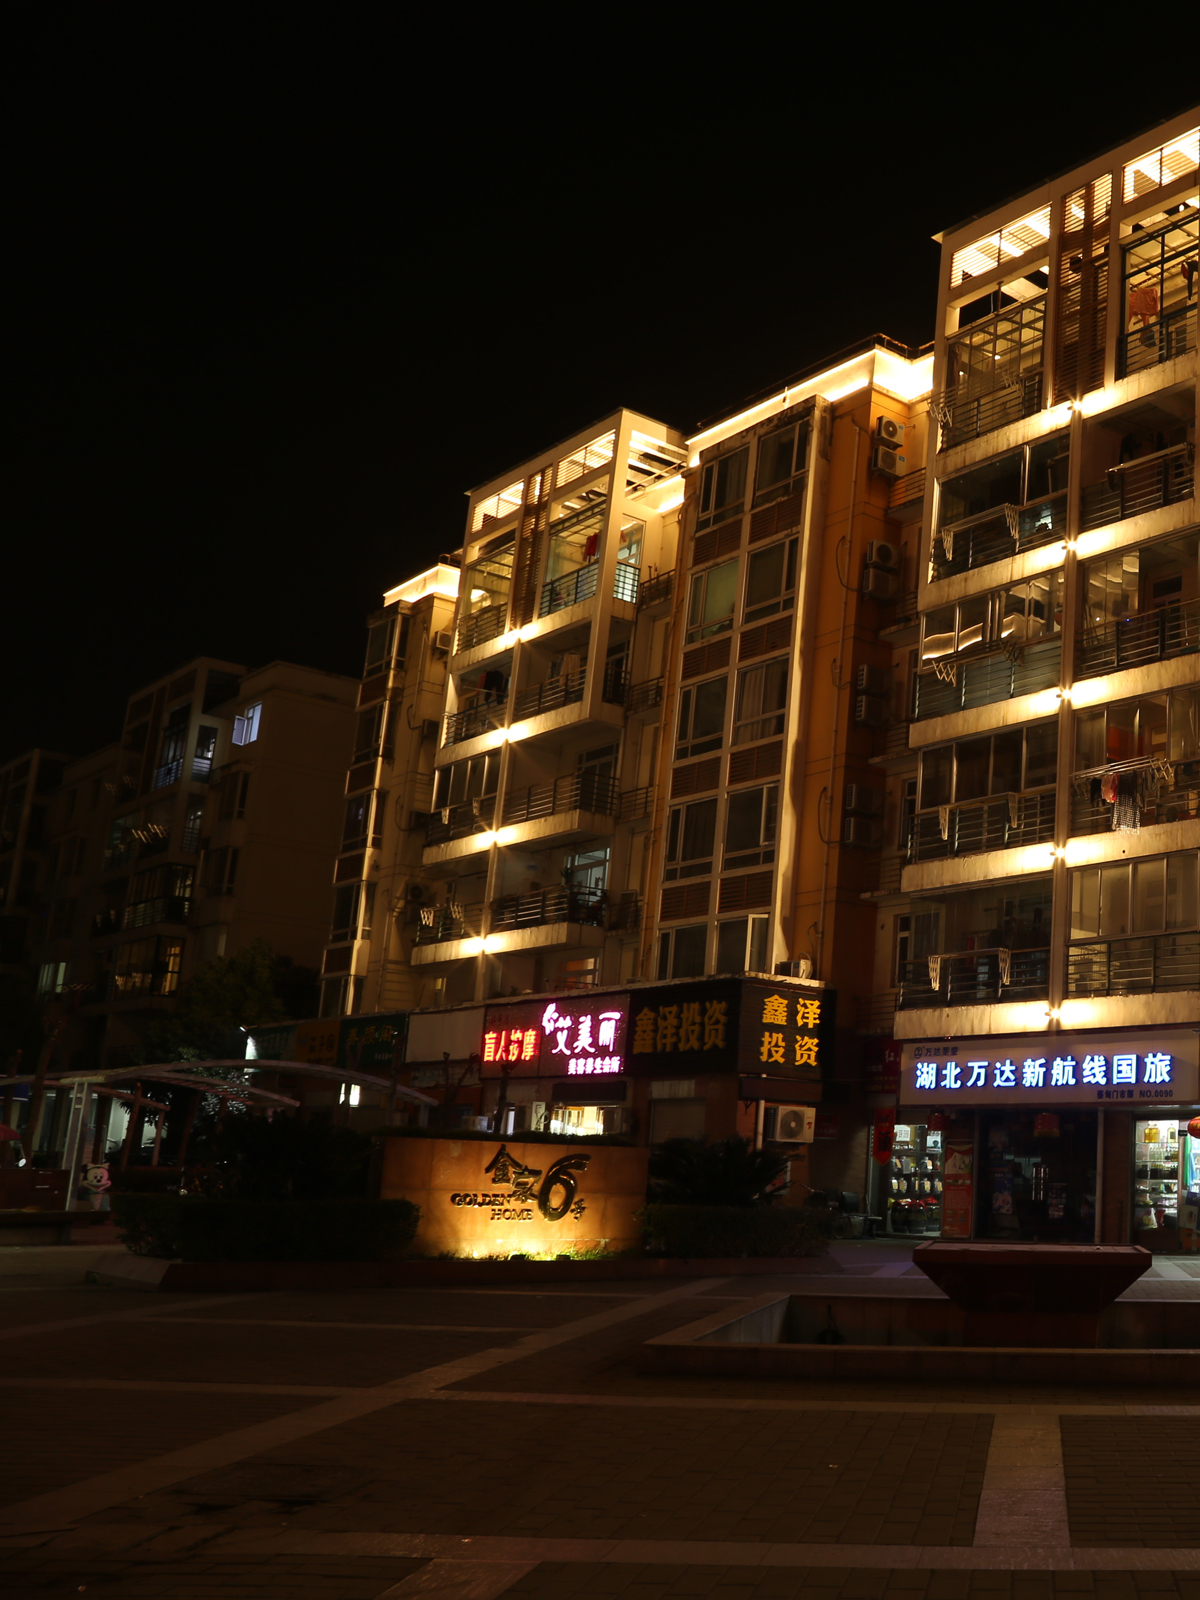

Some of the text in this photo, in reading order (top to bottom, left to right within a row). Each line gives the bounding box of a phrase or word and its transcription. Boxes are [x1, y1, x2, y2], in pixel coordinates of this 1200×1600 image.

[633, 999, 729, 1055] 鑫泽投资
[762, 994, 821, 1029] 鑫泽
[483, 1028, 538, 1062] 盲人按摩
[760, 1031, 820, 1066] 投资
[914, 1052, 1174, 1090] 湖北万达新航线国旅
[1139, 1089, 1173, 1098] NO.0090
[450, 1193, 514, 1208] GOLDEN
[490, 1208, 534, 1221] HOME
